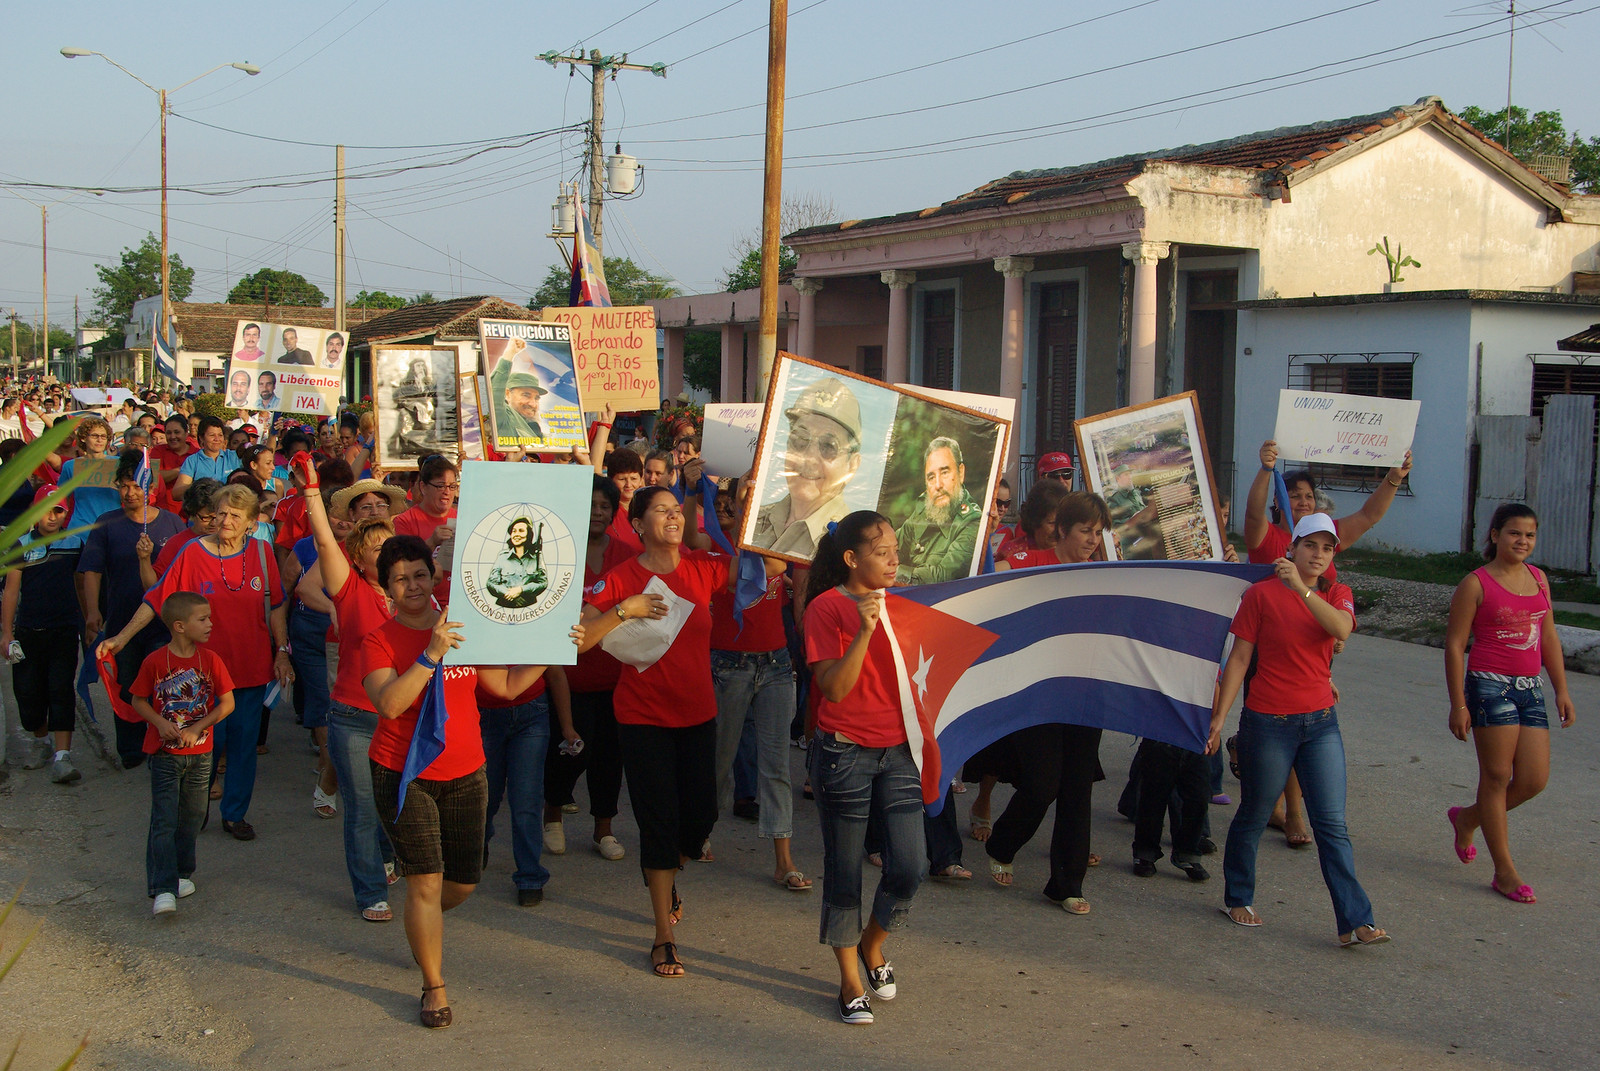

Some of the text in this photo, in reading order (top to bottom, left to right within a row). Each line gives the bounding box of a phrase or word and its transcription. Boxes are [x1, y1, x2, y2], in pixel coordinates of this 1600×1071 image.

[592, 310, 655, 330] MUJERES
[484, 323, 569, 341] REVOLUCIÓN ES
[280, 374, 340, 388] Libérenlos
[603, 373, 616, 391] de
[296, 396, 320, 410] ¡YA!
[1294, 397, 1334, 410] UNIDAD
[498, 436, 541, 446] CUALQUIER
[1337, 432, 1389, 447] VICTORIA
[1150, 466, 1190, 482] REVOLUCIÓN
[200, 581, 215, 595] 12
[464, 571, 494, 617] FEDERACIÓN
[495, 611, 507, 621] DE
[508, 608, 545, 622] MUJERES
[545, 571, 572, 609] CUBANAS
